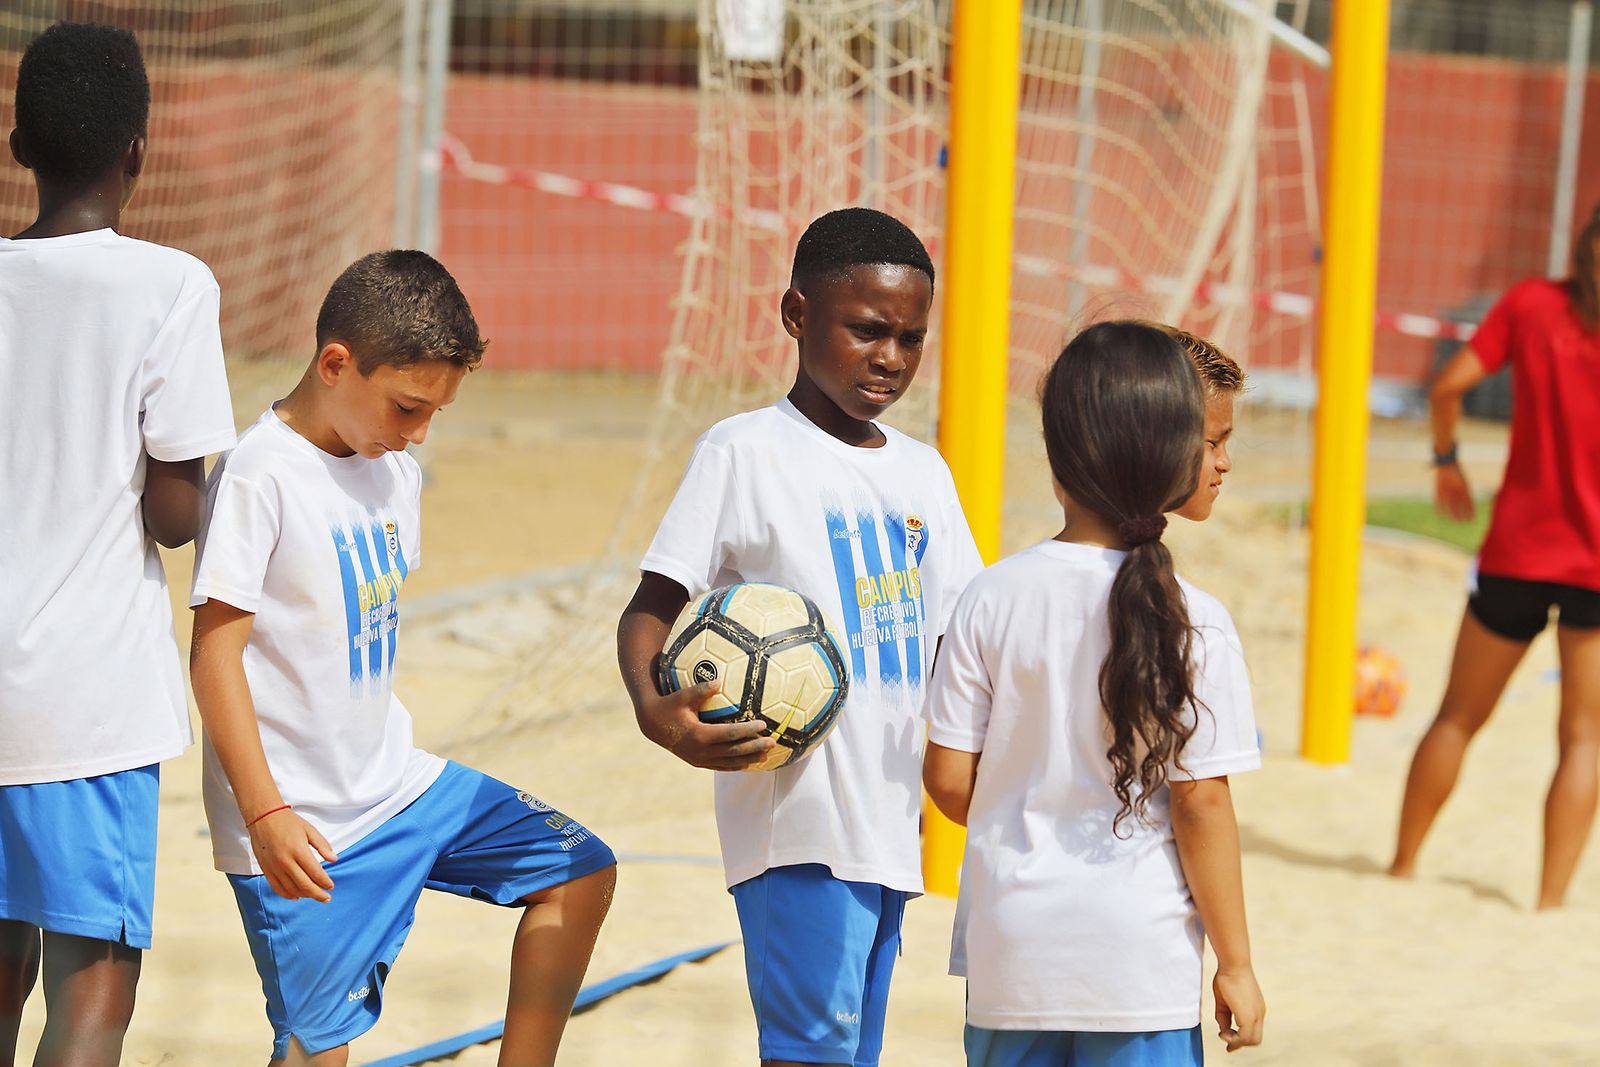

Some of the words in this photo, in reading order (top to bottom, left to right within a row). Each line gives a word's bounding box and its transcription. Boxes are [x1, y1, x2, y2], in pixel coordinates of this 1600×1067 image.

[855, 567, 922, 610] CAMPUS
[852, 626, 891, 649] HUELVA
[559, 832, 588, 852] HUELVA
